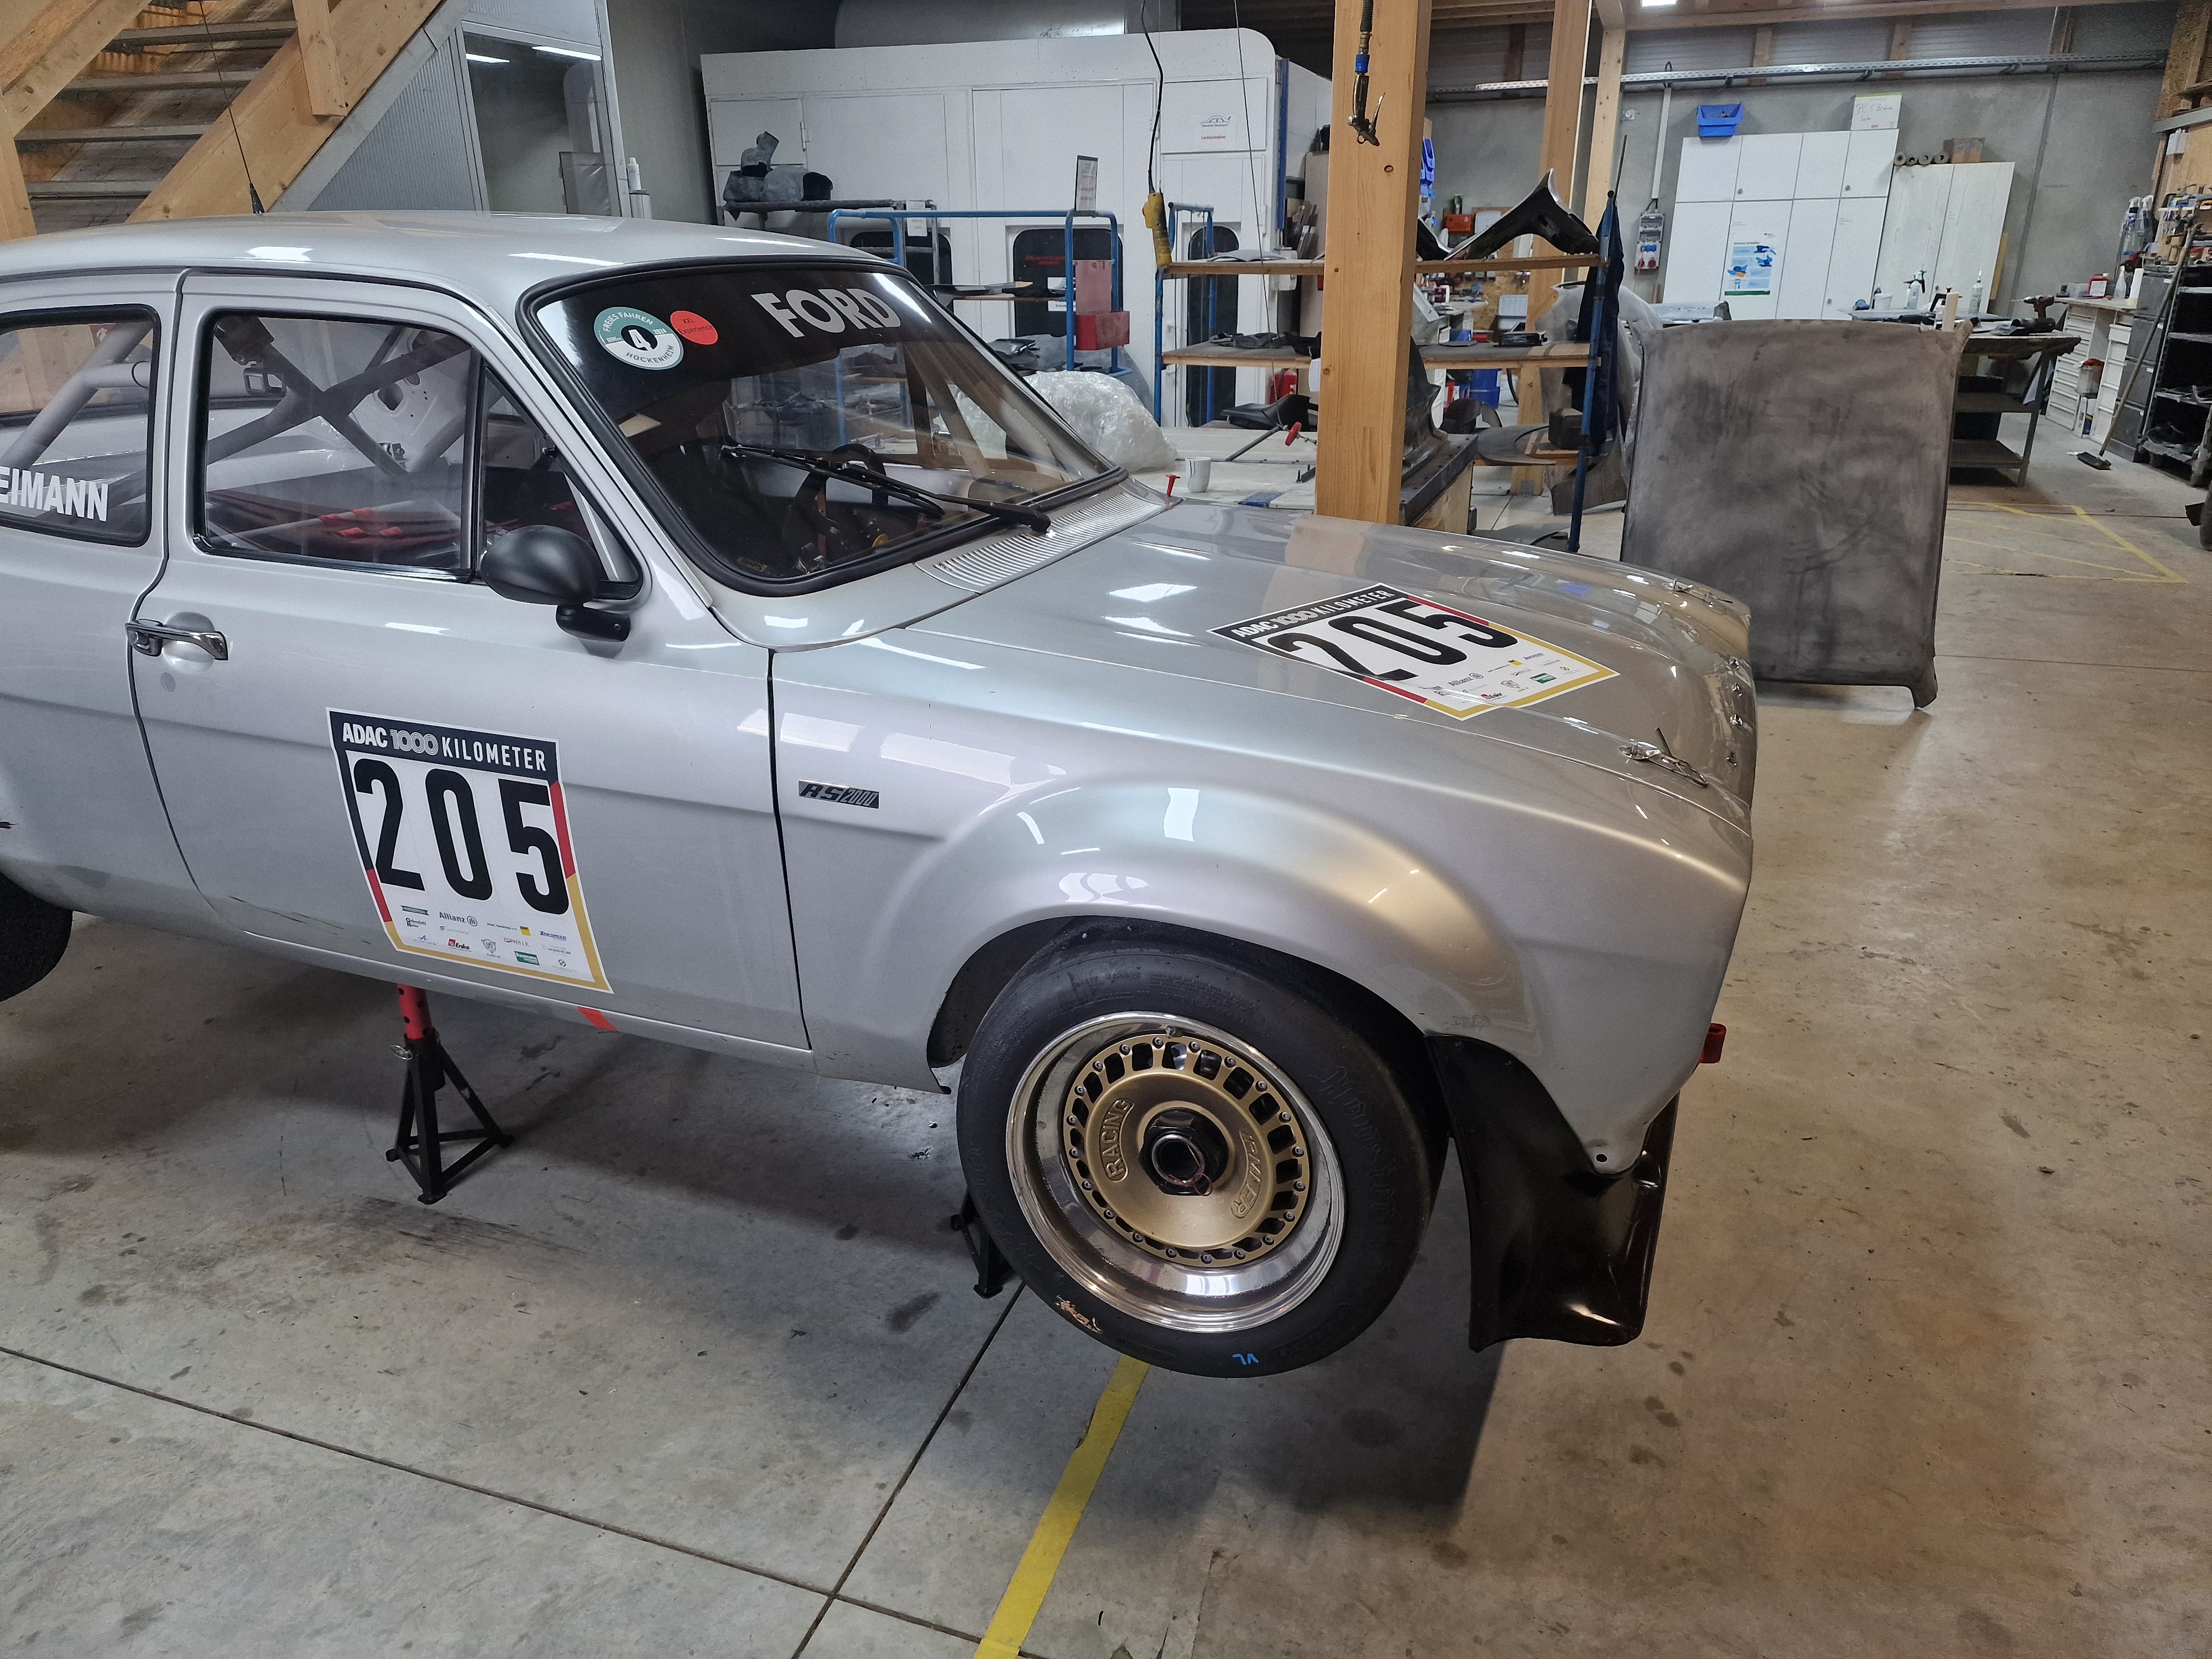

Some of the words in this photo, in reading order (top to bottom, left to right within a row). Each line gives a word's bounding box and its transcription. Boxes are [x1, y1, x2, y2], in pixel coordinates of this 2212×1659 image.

[603, 313, 619, 332] FREIES
[618, 311, 654, 326] FAHREN
[750, 288, 901, 338] FORD
[628, 328, 654, 351] 4
[678, 325, 713, 335] Experience
[625, 345, 675, 363] HOCKENHEIM
[1230, 619, 1279, 638] ADAC
[1269, 610, 1318, 625] 1000
[1310, 589, 1396, 615] KILOMETER
[1267, 599, 1519, 681] 205
[1448, 676, 1474, 687] Allianz
[342, 722, 388, 748] ADAC
[389, 729, 439, 756] 1000
[442, 736, 547, 772] KILOMETER
[353, 758, 570, 915] 205
[439, 911, 466, 924] Allianz
[1101, 1099, 1131, 1178] RACING
[1232, 1353, 1260, 1366] VL
